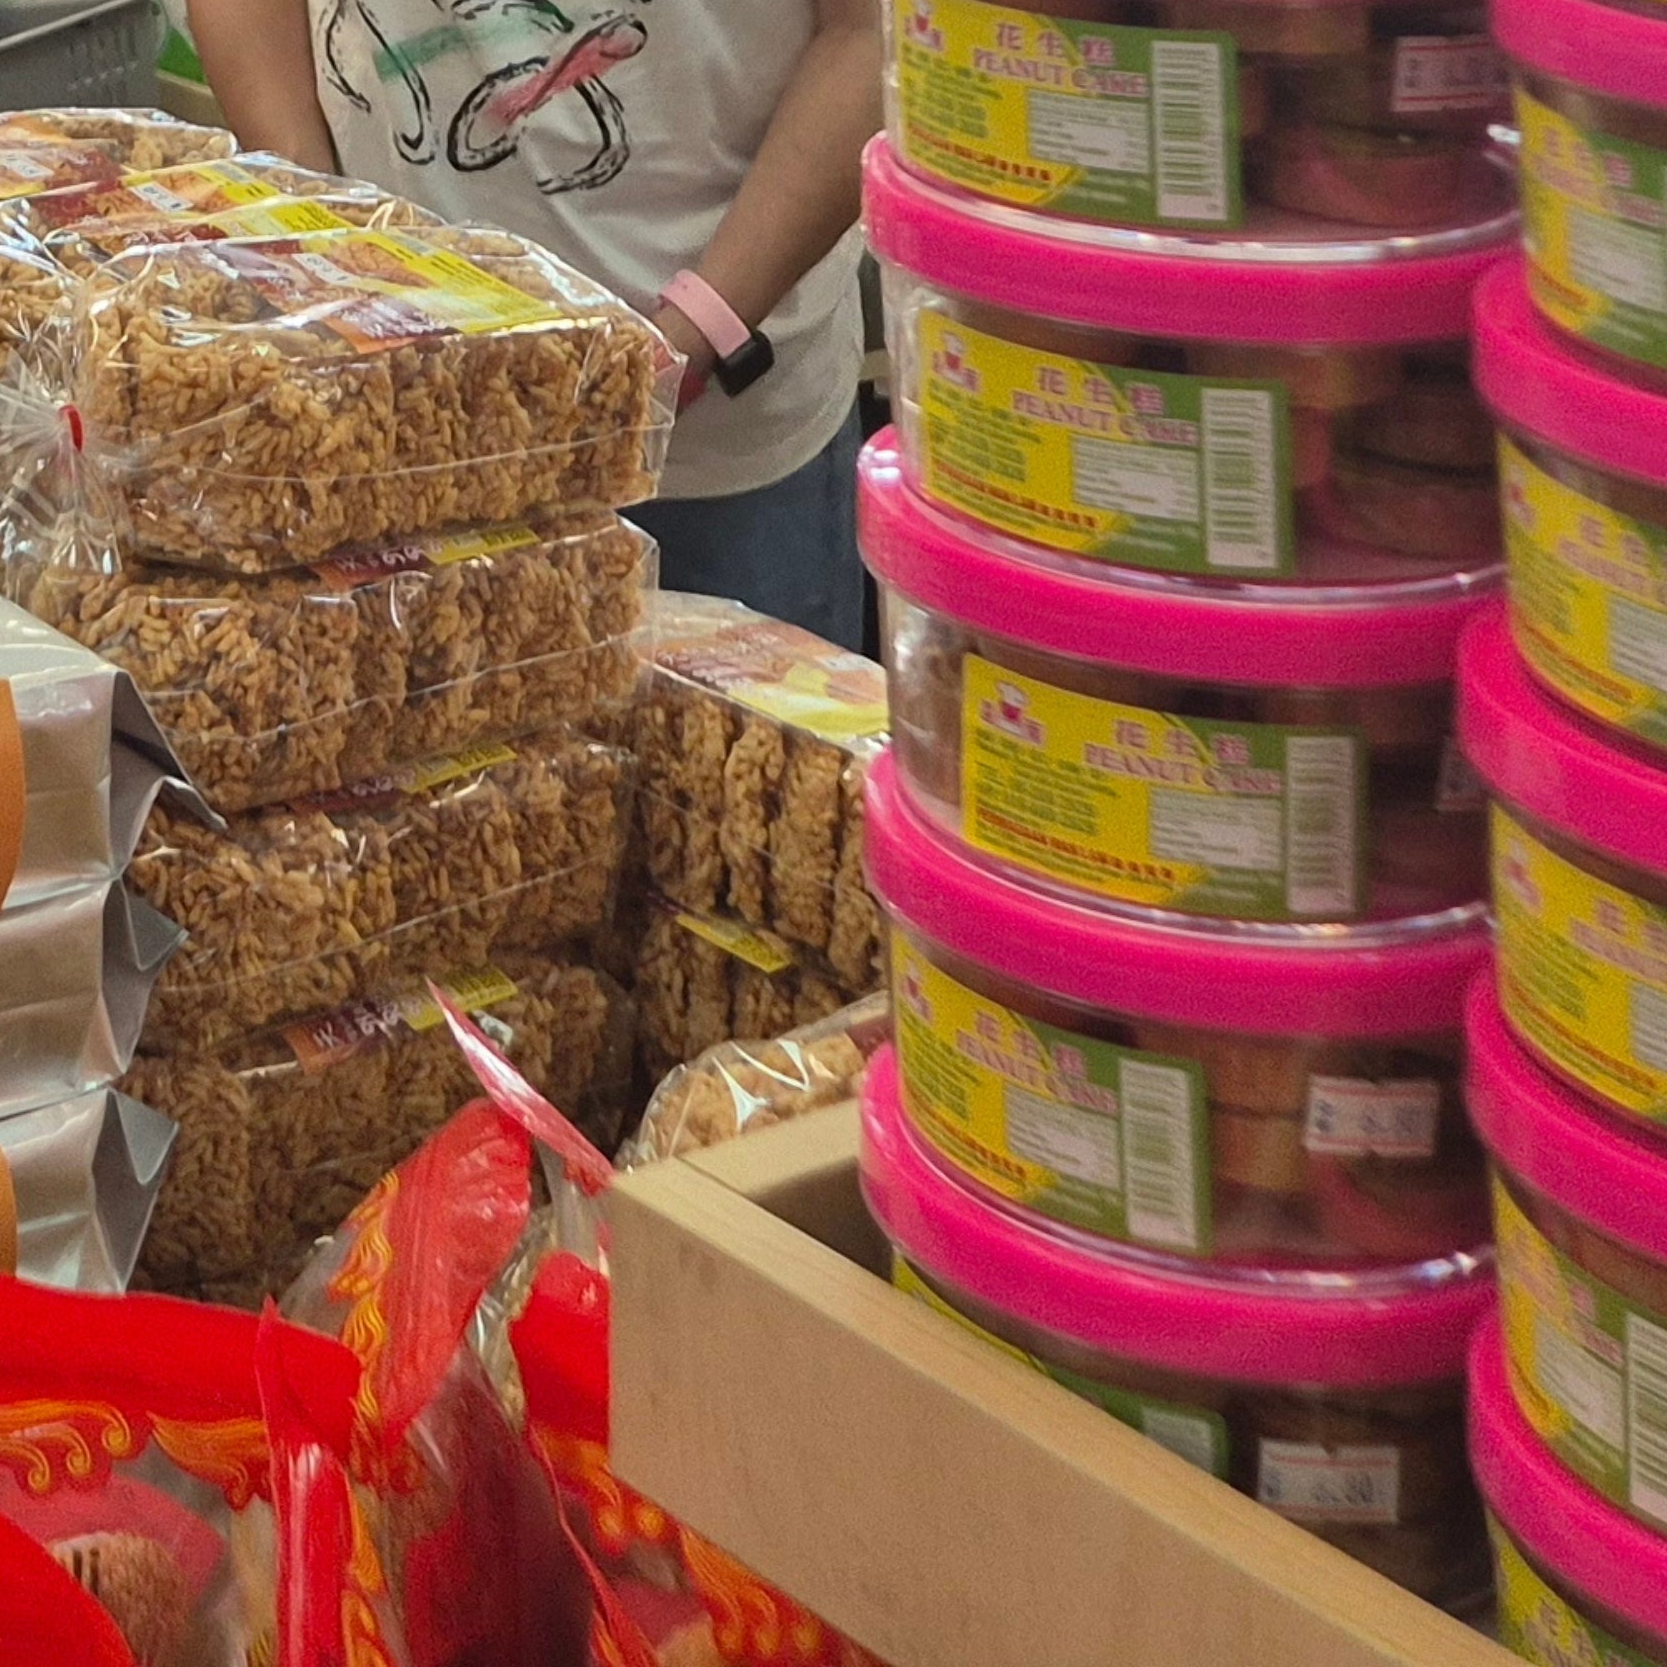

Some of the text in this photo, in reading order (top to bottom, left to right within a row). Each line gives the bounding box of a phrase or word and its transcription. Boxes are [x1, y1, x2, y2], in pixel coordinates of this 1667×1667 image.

[974, 49, 1149, 99] PEANUT CAKE
[1013, 389, 1199, 447] PEANUT CAKE
[1084, 742, 1193, 785] PEANUT
